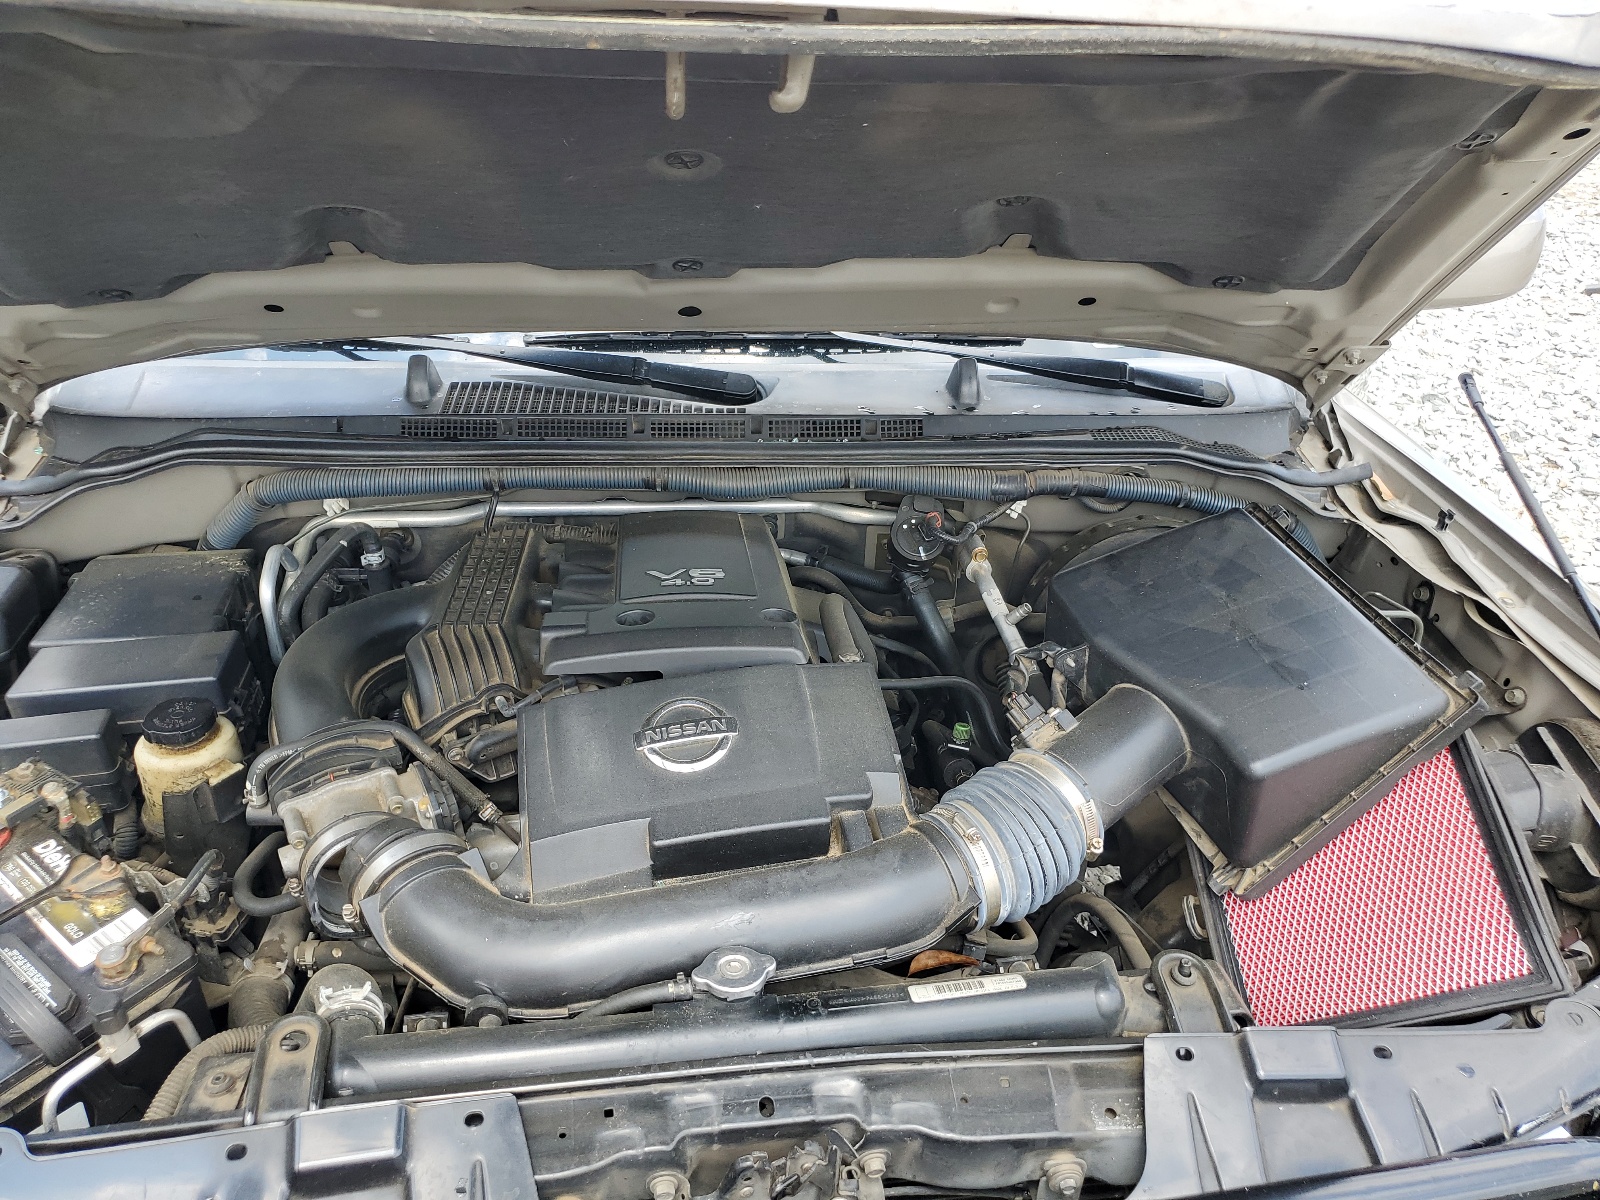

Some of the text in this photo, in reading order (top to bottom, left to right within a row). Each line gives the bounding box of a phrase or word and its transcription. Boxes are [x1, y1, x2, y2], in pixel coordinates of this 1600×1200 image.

[645, 568, 726, 580] V6
[660, 577, 715, 587] 4.0
[644, 719, 728, 743] NISSAN
[32, 839, 72, 876] DieH
[63, 922, 84, 939] GOLD
